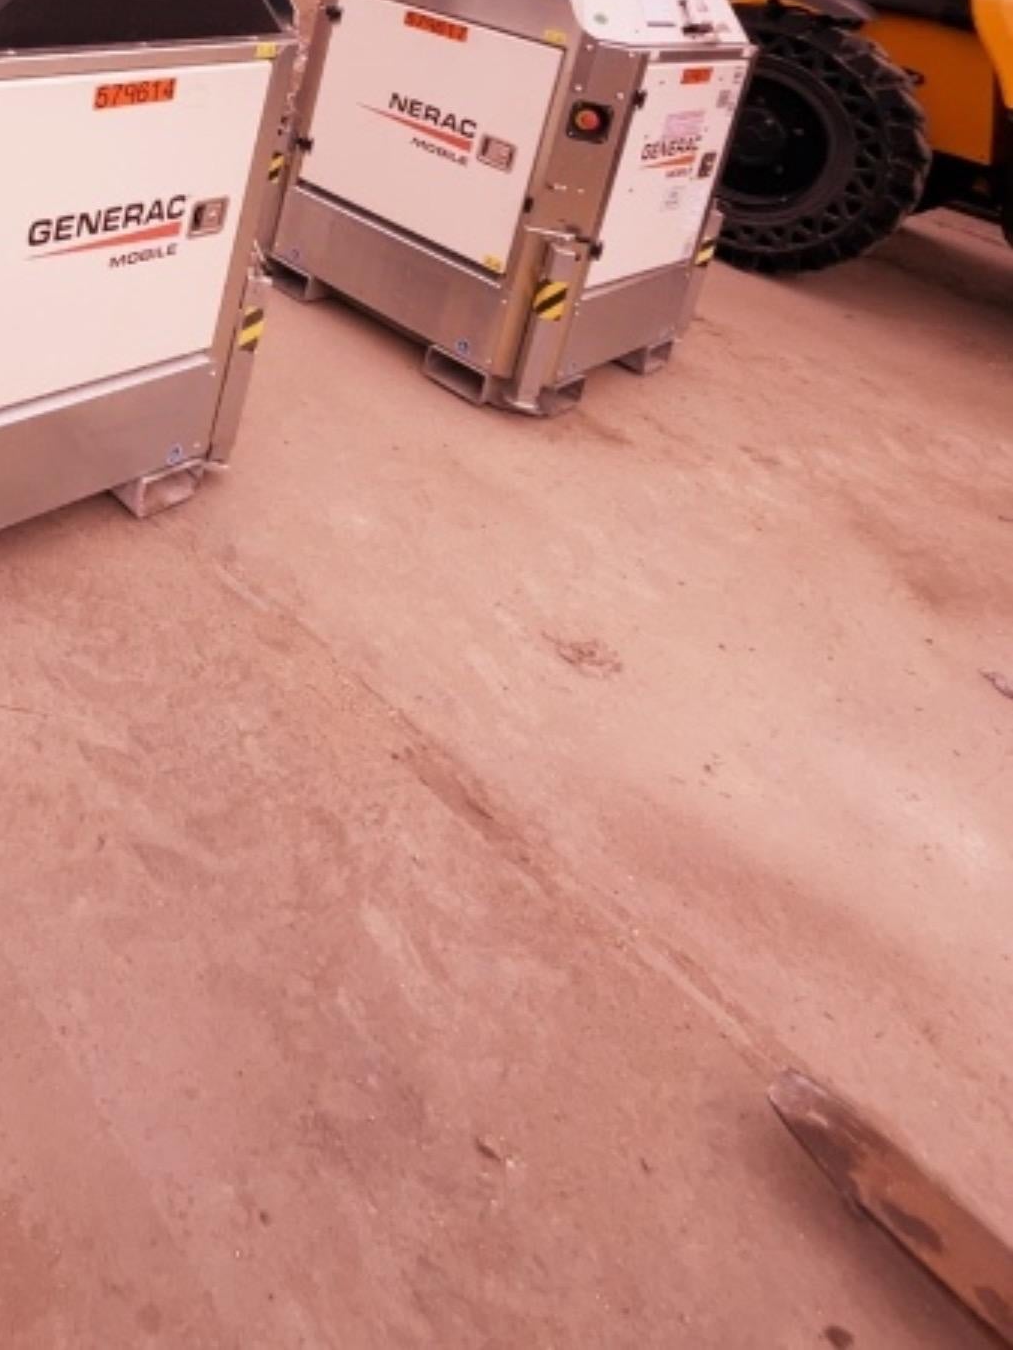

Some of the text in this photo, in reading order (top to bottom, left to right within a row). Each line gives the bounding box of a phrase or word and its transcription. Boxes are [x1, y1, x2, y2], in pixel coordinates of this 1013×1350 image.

[388, 92, 477, 139] NERAC
[28, 194, 188, 247] GENERAC
[108, 242, 178, 268] MOBILE
